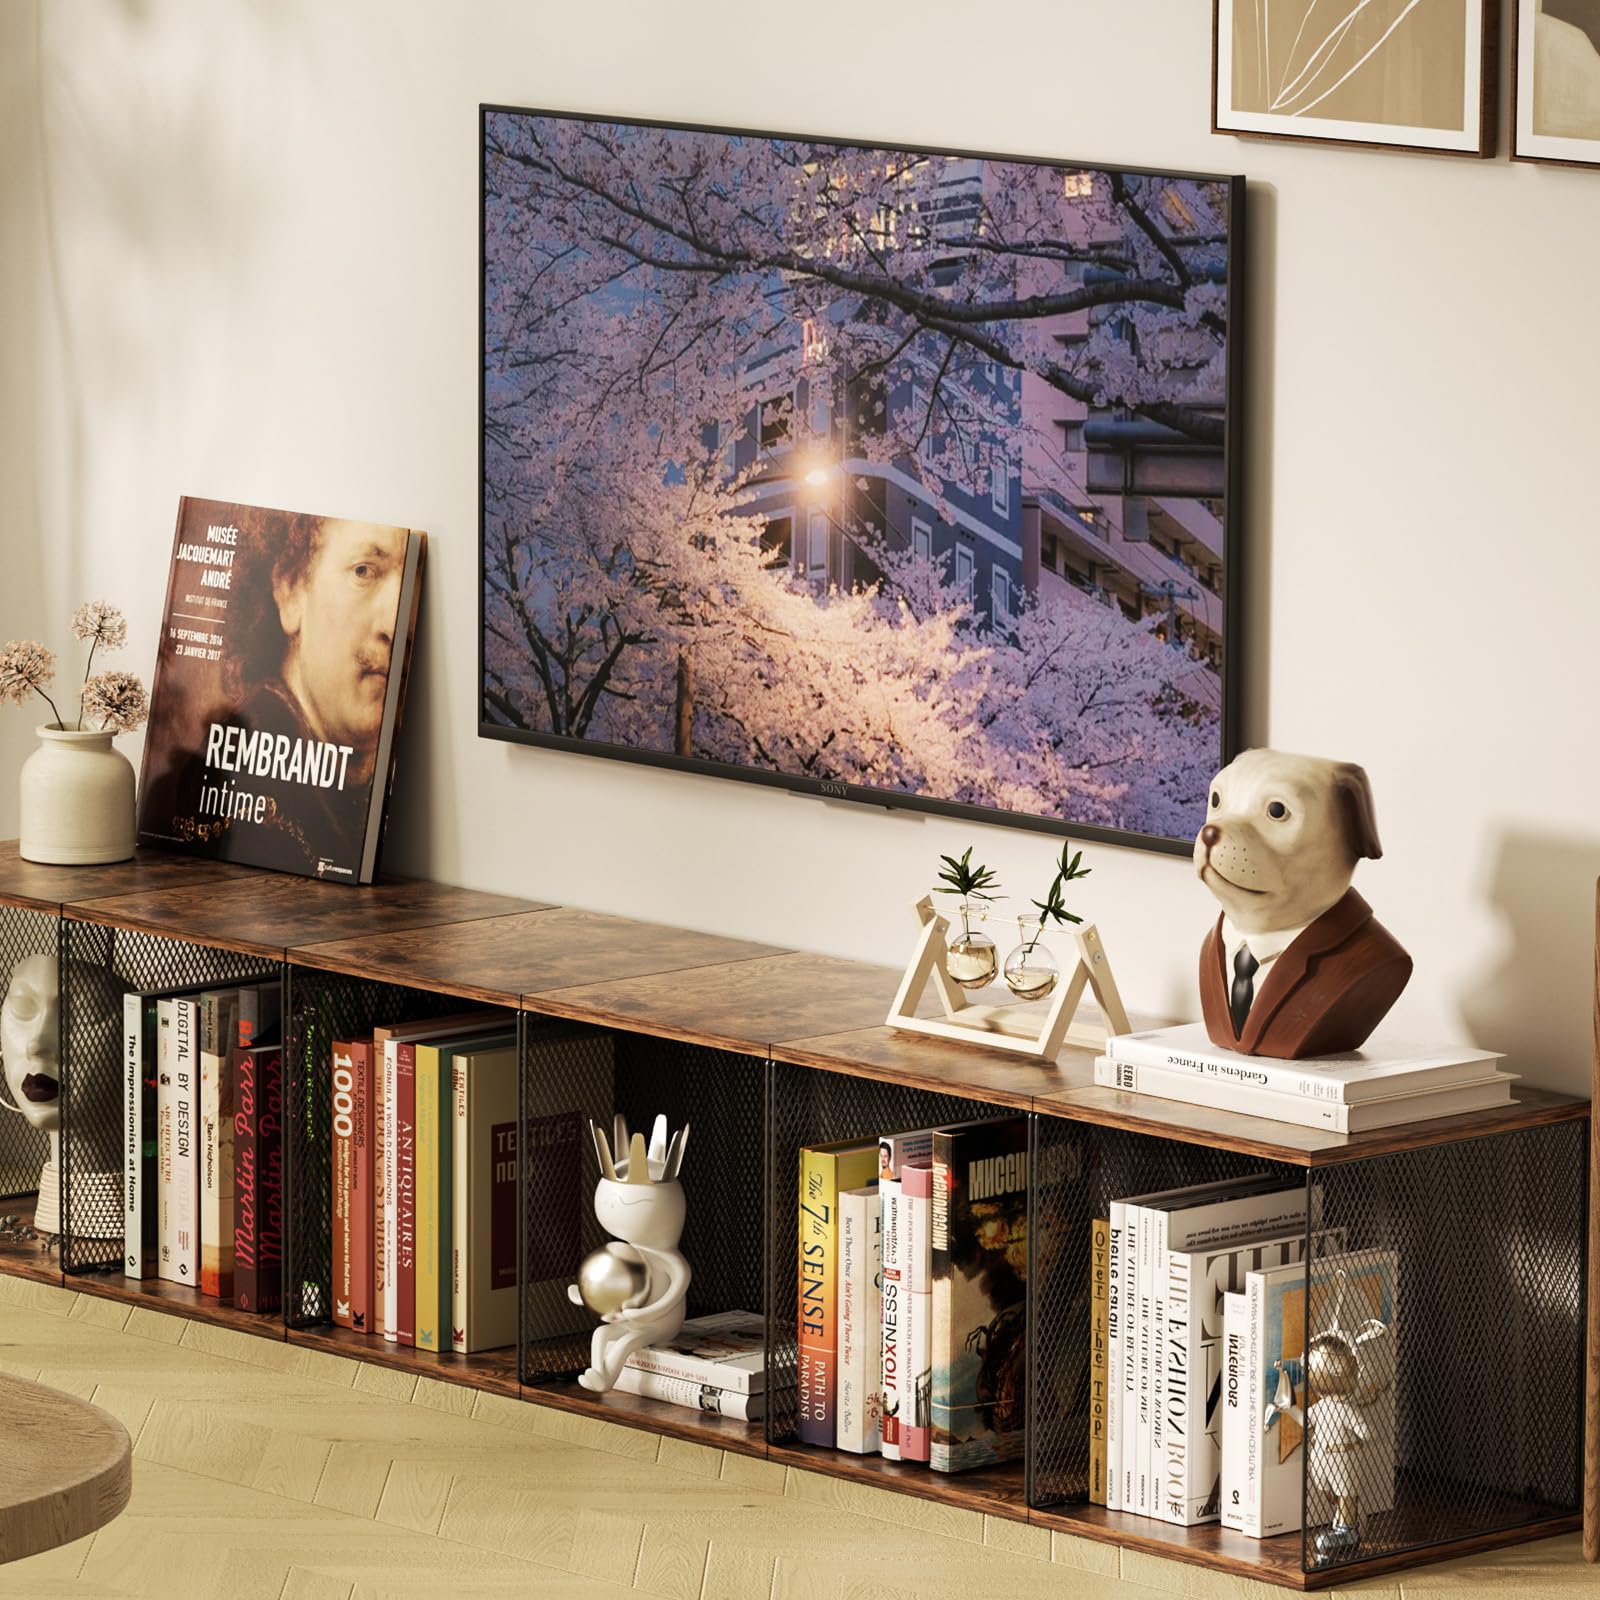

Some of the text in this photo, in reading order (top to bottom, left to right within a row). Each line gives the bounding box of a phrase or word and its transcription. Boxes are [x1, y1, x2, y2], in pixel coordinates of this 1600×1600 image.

[176, 543, 236, 567] JACQUEMART
[206, 524, 239, 546] MUSÉE
[200, 569, 233, 590] ANDRÉ
[169, 627, 177, 638] 16
[177, 628, 209, 644] SEPTEMBRE
[175, 644, 221, 661] 23 JANVIER 2017
[205, 722, 353, 791] REMBRANDT
[199, 774, 267, 825] intime
[820, 782, 849, 796] SONY
[177, 1001, 190, 1158] DIGITAL BY DESIGN
[234, 1055, 255, 1137] Parr
[333, 1052, 353, 1137] 1000
[385, 1057, 393, 1103] FORMULA
[1123, 1064, 1134, 1088] EERO
[1167, 1056, 1268, 1085] Gardens in France
[127, 1034, 137, 1213] The Impressionists at Home
[357, 1059, 365, 1148] TEXTILE DESIGNERS
[375, 1103, 385, 1162] BOOK
[385, 1111, 393, 1147] WORLD
[206, 1123, 214, 1188] Ben Nicholson
[342, 1139, 350, 1165] designs
[343, 1167, 351, 1177] for
[385, 1149, 393, 1206] CHAMPIONS
[968, 1152, 1028, 1201] МИССИ
[234, 1146, 255, 1265] Martin
[399, 1121, 413, 1269] ANTIQUAIRES
[932, 1162, 948, 1251] МИССИОНЕРЫ
[375, 1185, 385, 1293] SYMBOLS
[800, 1170, 830, 1337] The 7th SENSE
[890, 1197, 898, 1256] ЧУДОВИЩЕМ
[343, 1254, 350, 1262] to
[843, 1216, 853, 1366] Been There Once Ain't Going There Twice
[884, 1284, 898, 1391] ЛОХNESS
[1094, 1231, 1105, 1435] Over the Top
[800, 1354, 810, 1421] PARADISE
[814, 1360, 826, 1421] PATH TO
